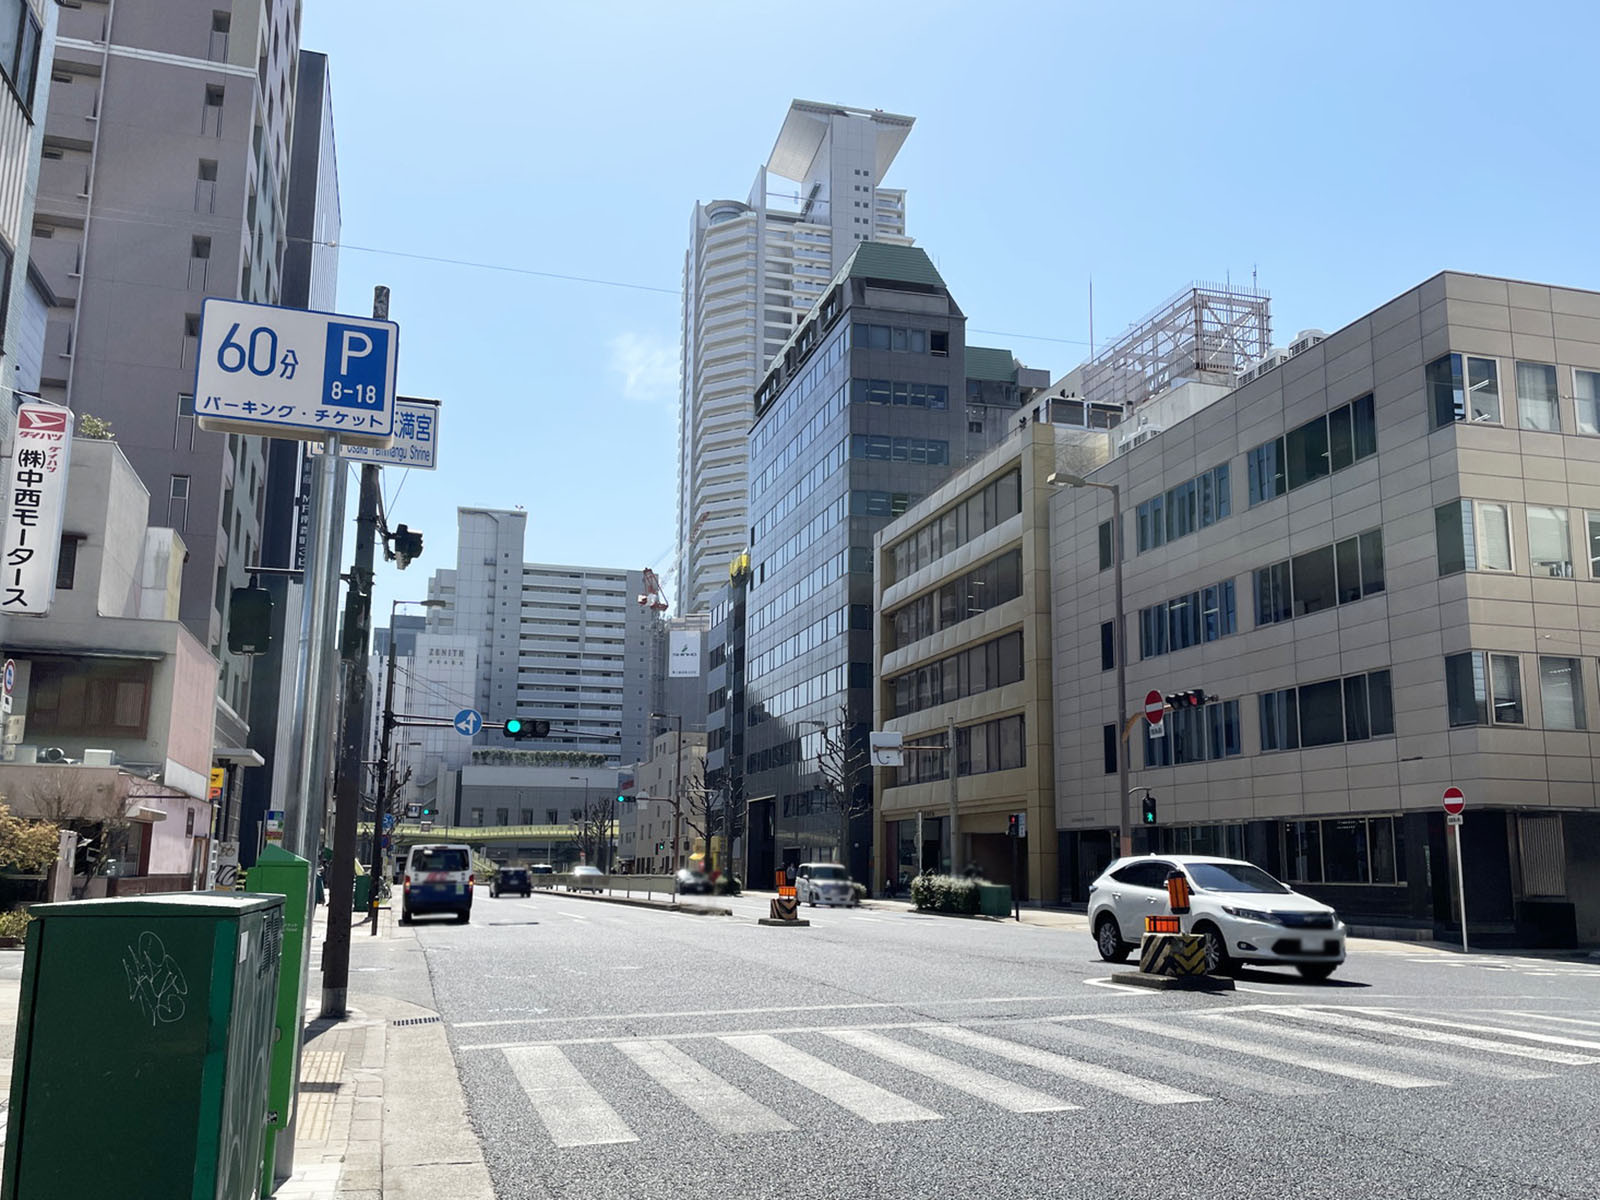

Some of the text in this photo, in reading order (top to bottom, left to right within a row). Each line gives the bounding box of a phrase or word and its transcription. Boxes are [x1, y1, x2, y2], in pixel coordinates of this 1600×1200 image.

[217, 323, 299, 380] 60分
[340, 330, 373, 376] P
[331, 381, 376, 404] 8-18
[394, 411, 432, 442] 満宮
[409, 444, 430, 461] Shrine
[2, 448, 46, 606] (株)中西モータース
[428, 648, 464, 657] ZENITH
